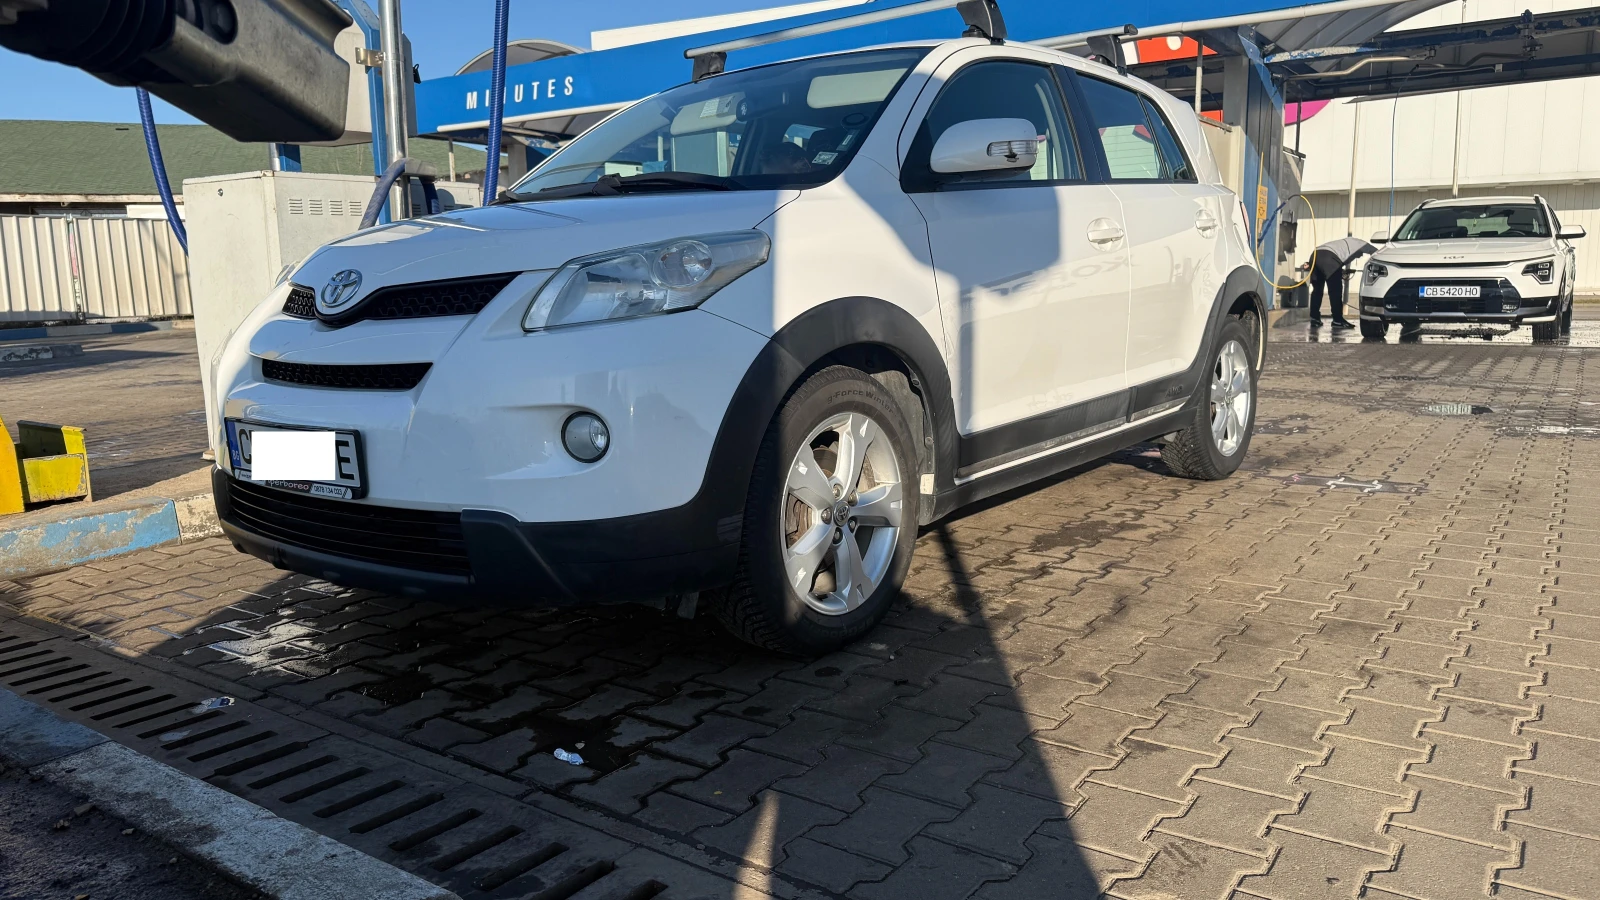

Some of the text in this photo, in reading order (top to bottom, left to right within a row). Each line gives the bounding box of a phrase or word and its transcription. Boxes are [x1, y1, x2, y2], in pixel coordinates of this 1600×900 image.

[1425, 287, 1438, 296] CB
[1439, 287, 1463, 296] 5420
[827, 389, 894, 414] g-Force Winter
[239, 429, 252, 464] C
